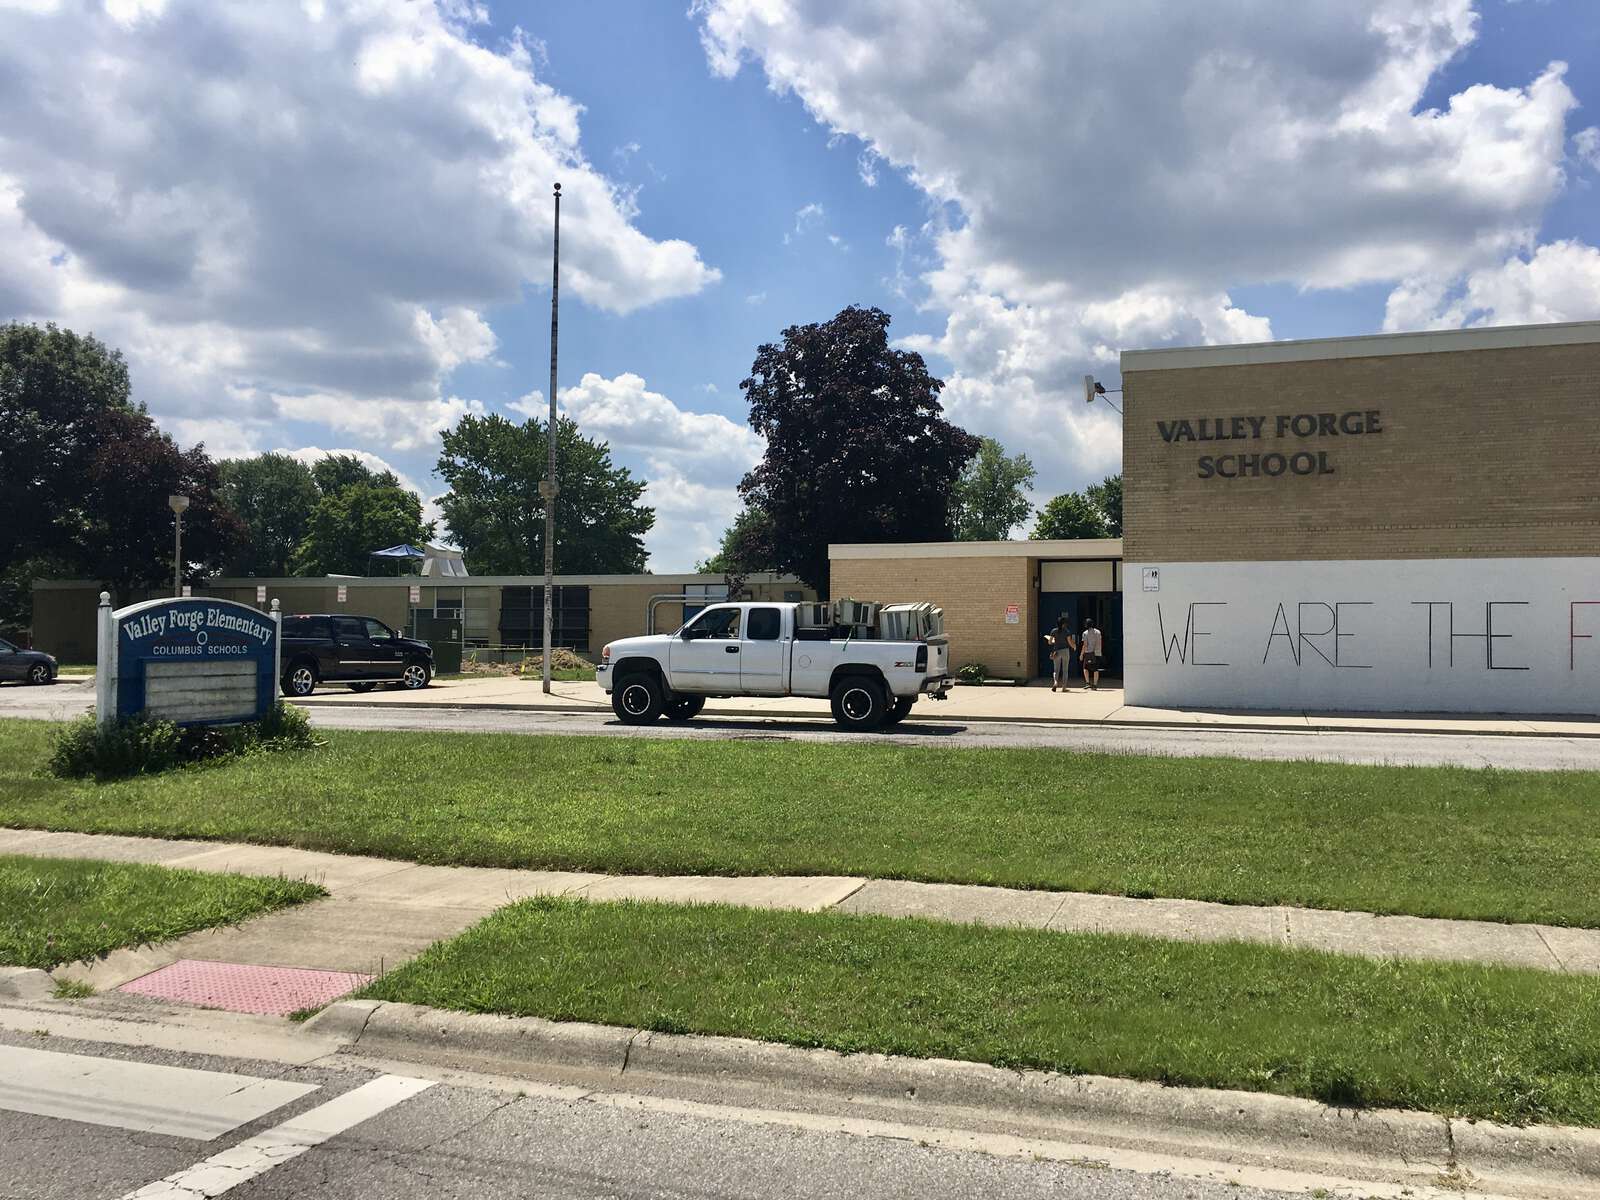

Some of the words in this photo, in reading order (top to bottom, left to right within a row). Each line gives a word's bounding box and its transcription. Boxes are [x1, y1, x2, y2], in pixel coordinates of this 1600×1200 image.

[1157, 416, 1266, 443] VALLEY
[1276, 410, 1383, 438] FORGE
[1198, 451, 1335, 478] SCHOOL
[123, 615, 167, 641] Valley
[169, 610, 204, 632] Forge
[207, 608, 272, 645] Elementary
[1157, 601, 1231, 666] WE
[1262, 601, 1374, 669] ARE
[1411, 601, 1530, 670] THE
[1570, 601, 1600, 671] F
[153, 645, 202, 655] COLUMBUS
[208, 645, 248, 654] SCHOOLS
